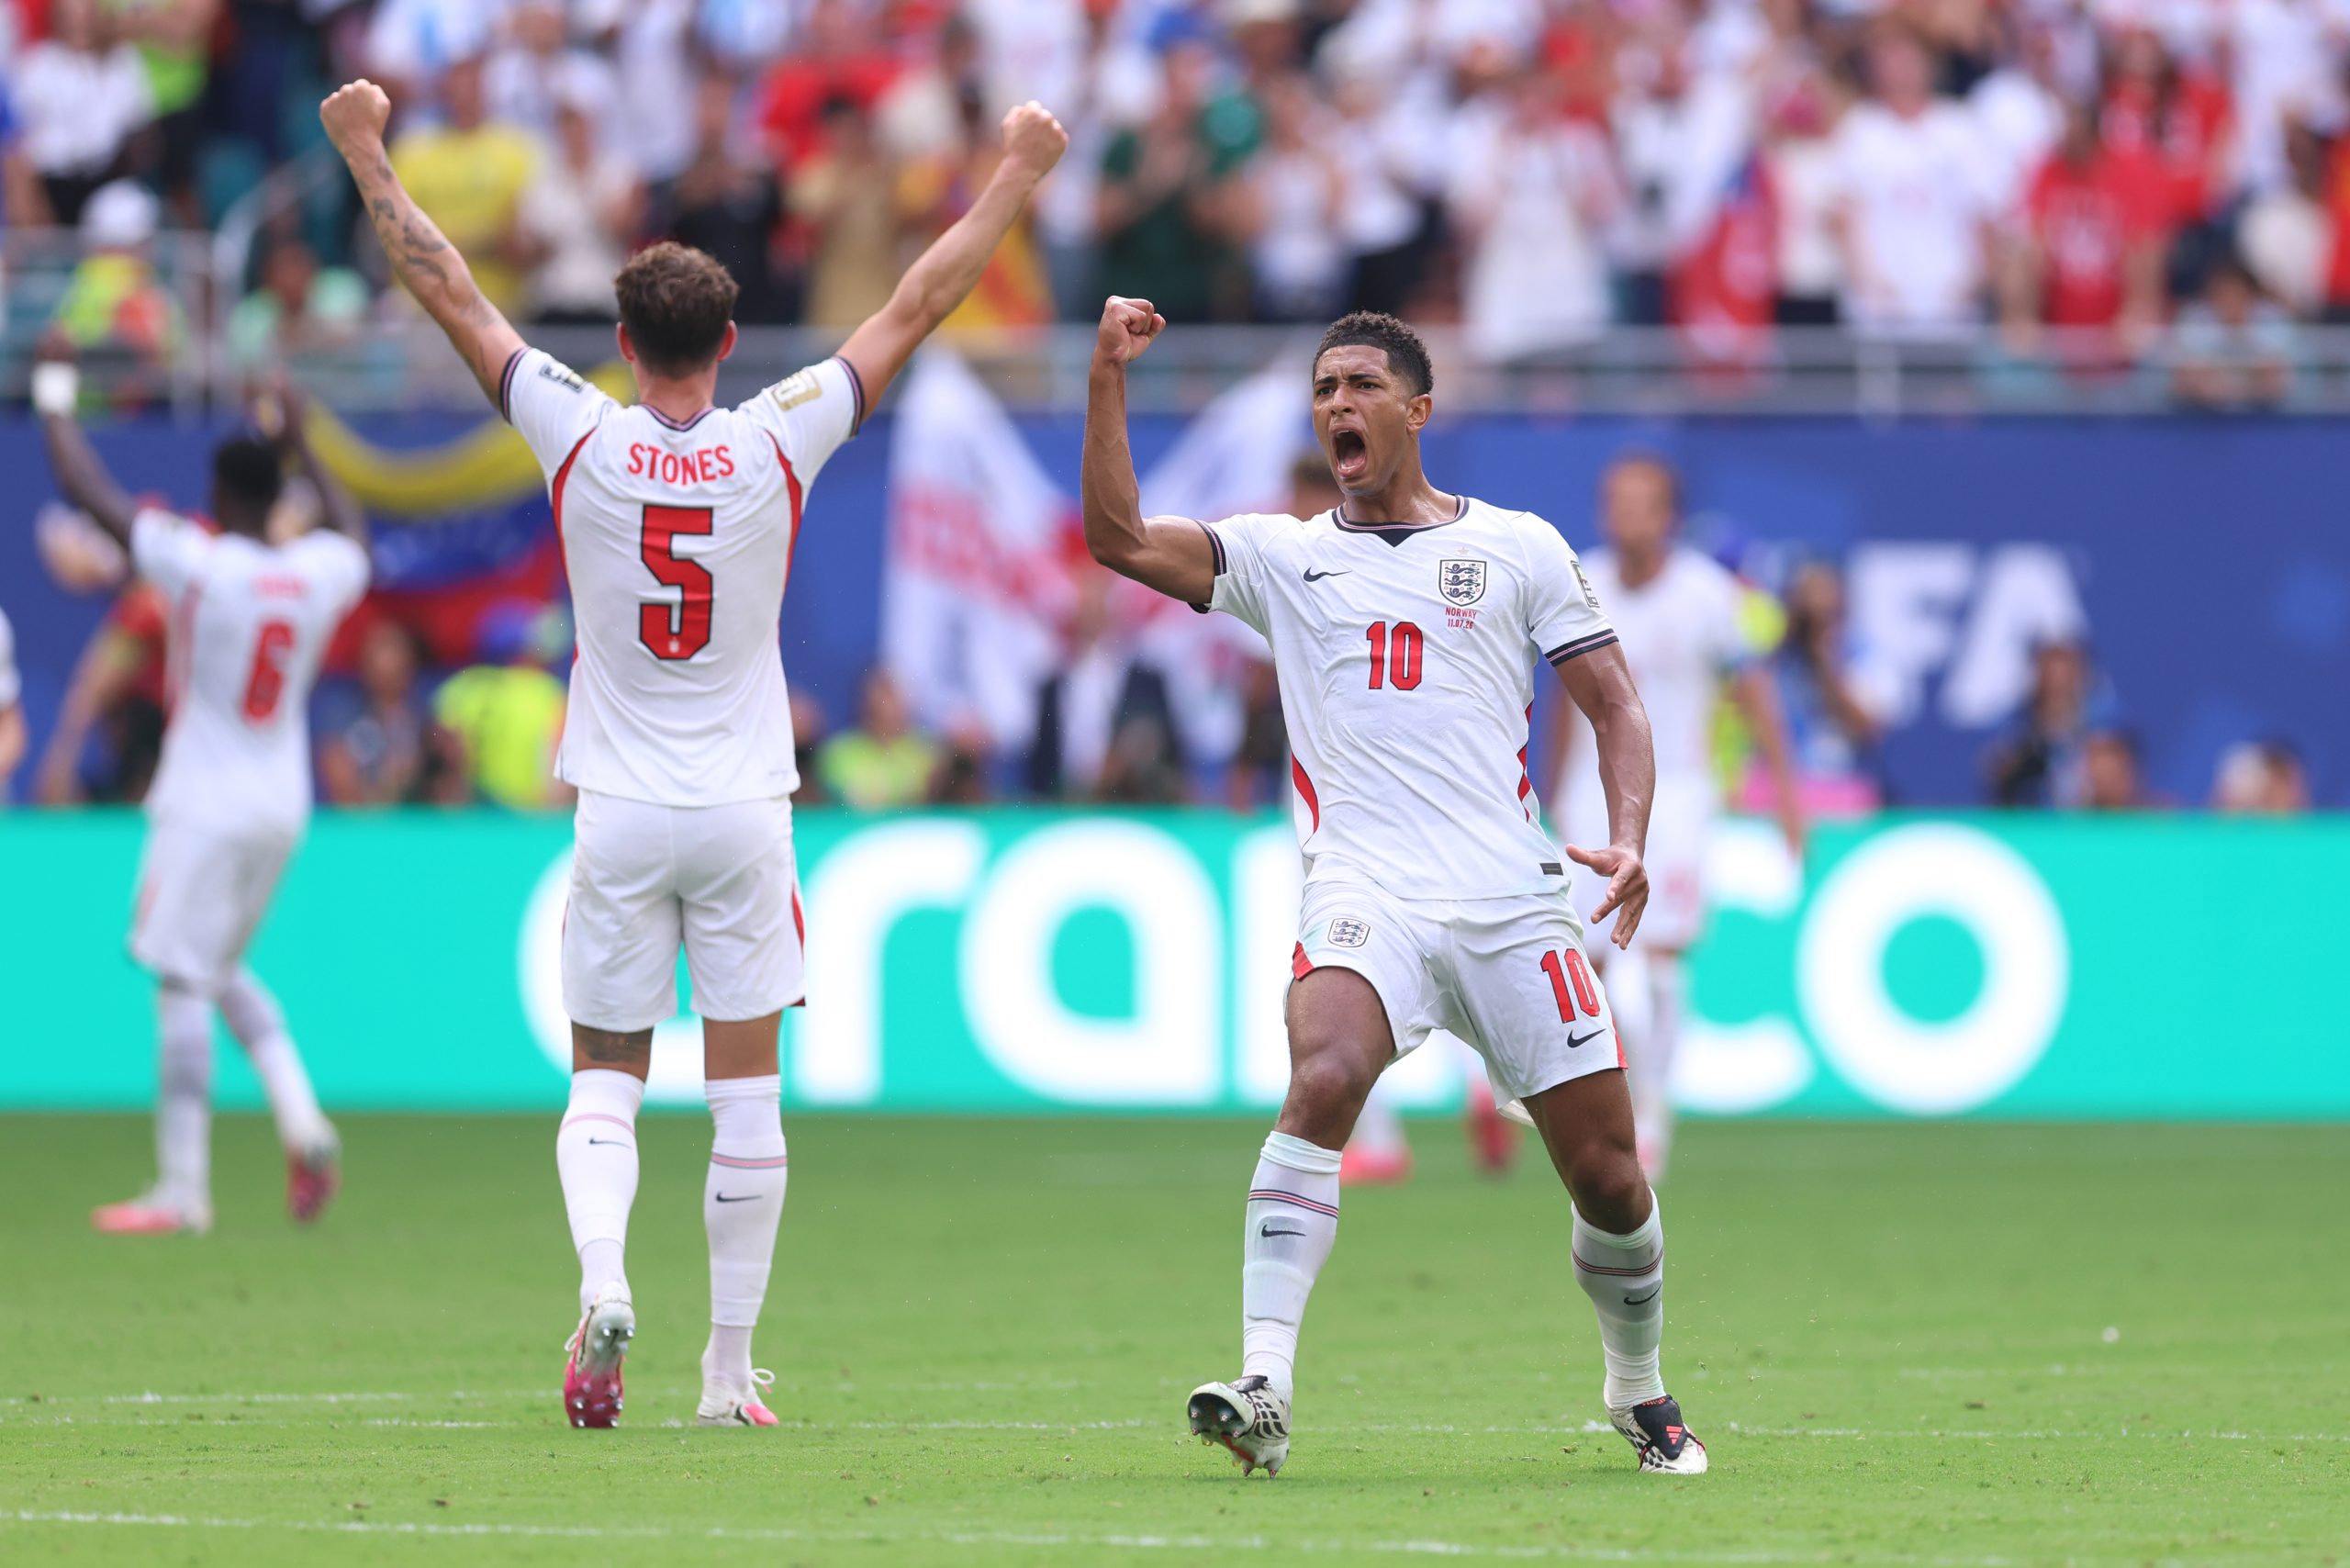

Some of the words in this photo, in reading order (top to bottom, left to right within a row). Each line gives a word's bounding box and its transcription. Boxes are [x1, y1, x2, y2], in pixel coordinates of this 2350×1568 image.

[627, 442, 735, 486] STONES
[640, 504, 713, 660] 5
[1445, 607, 1477, 619] NORWAY
[1366, 621, 1424, 690] 10
[1448, 618, 1474, 629] 11.07.26
[242, 621, 296, 722] 6
[1539, 947, 1601, 1025] 10
